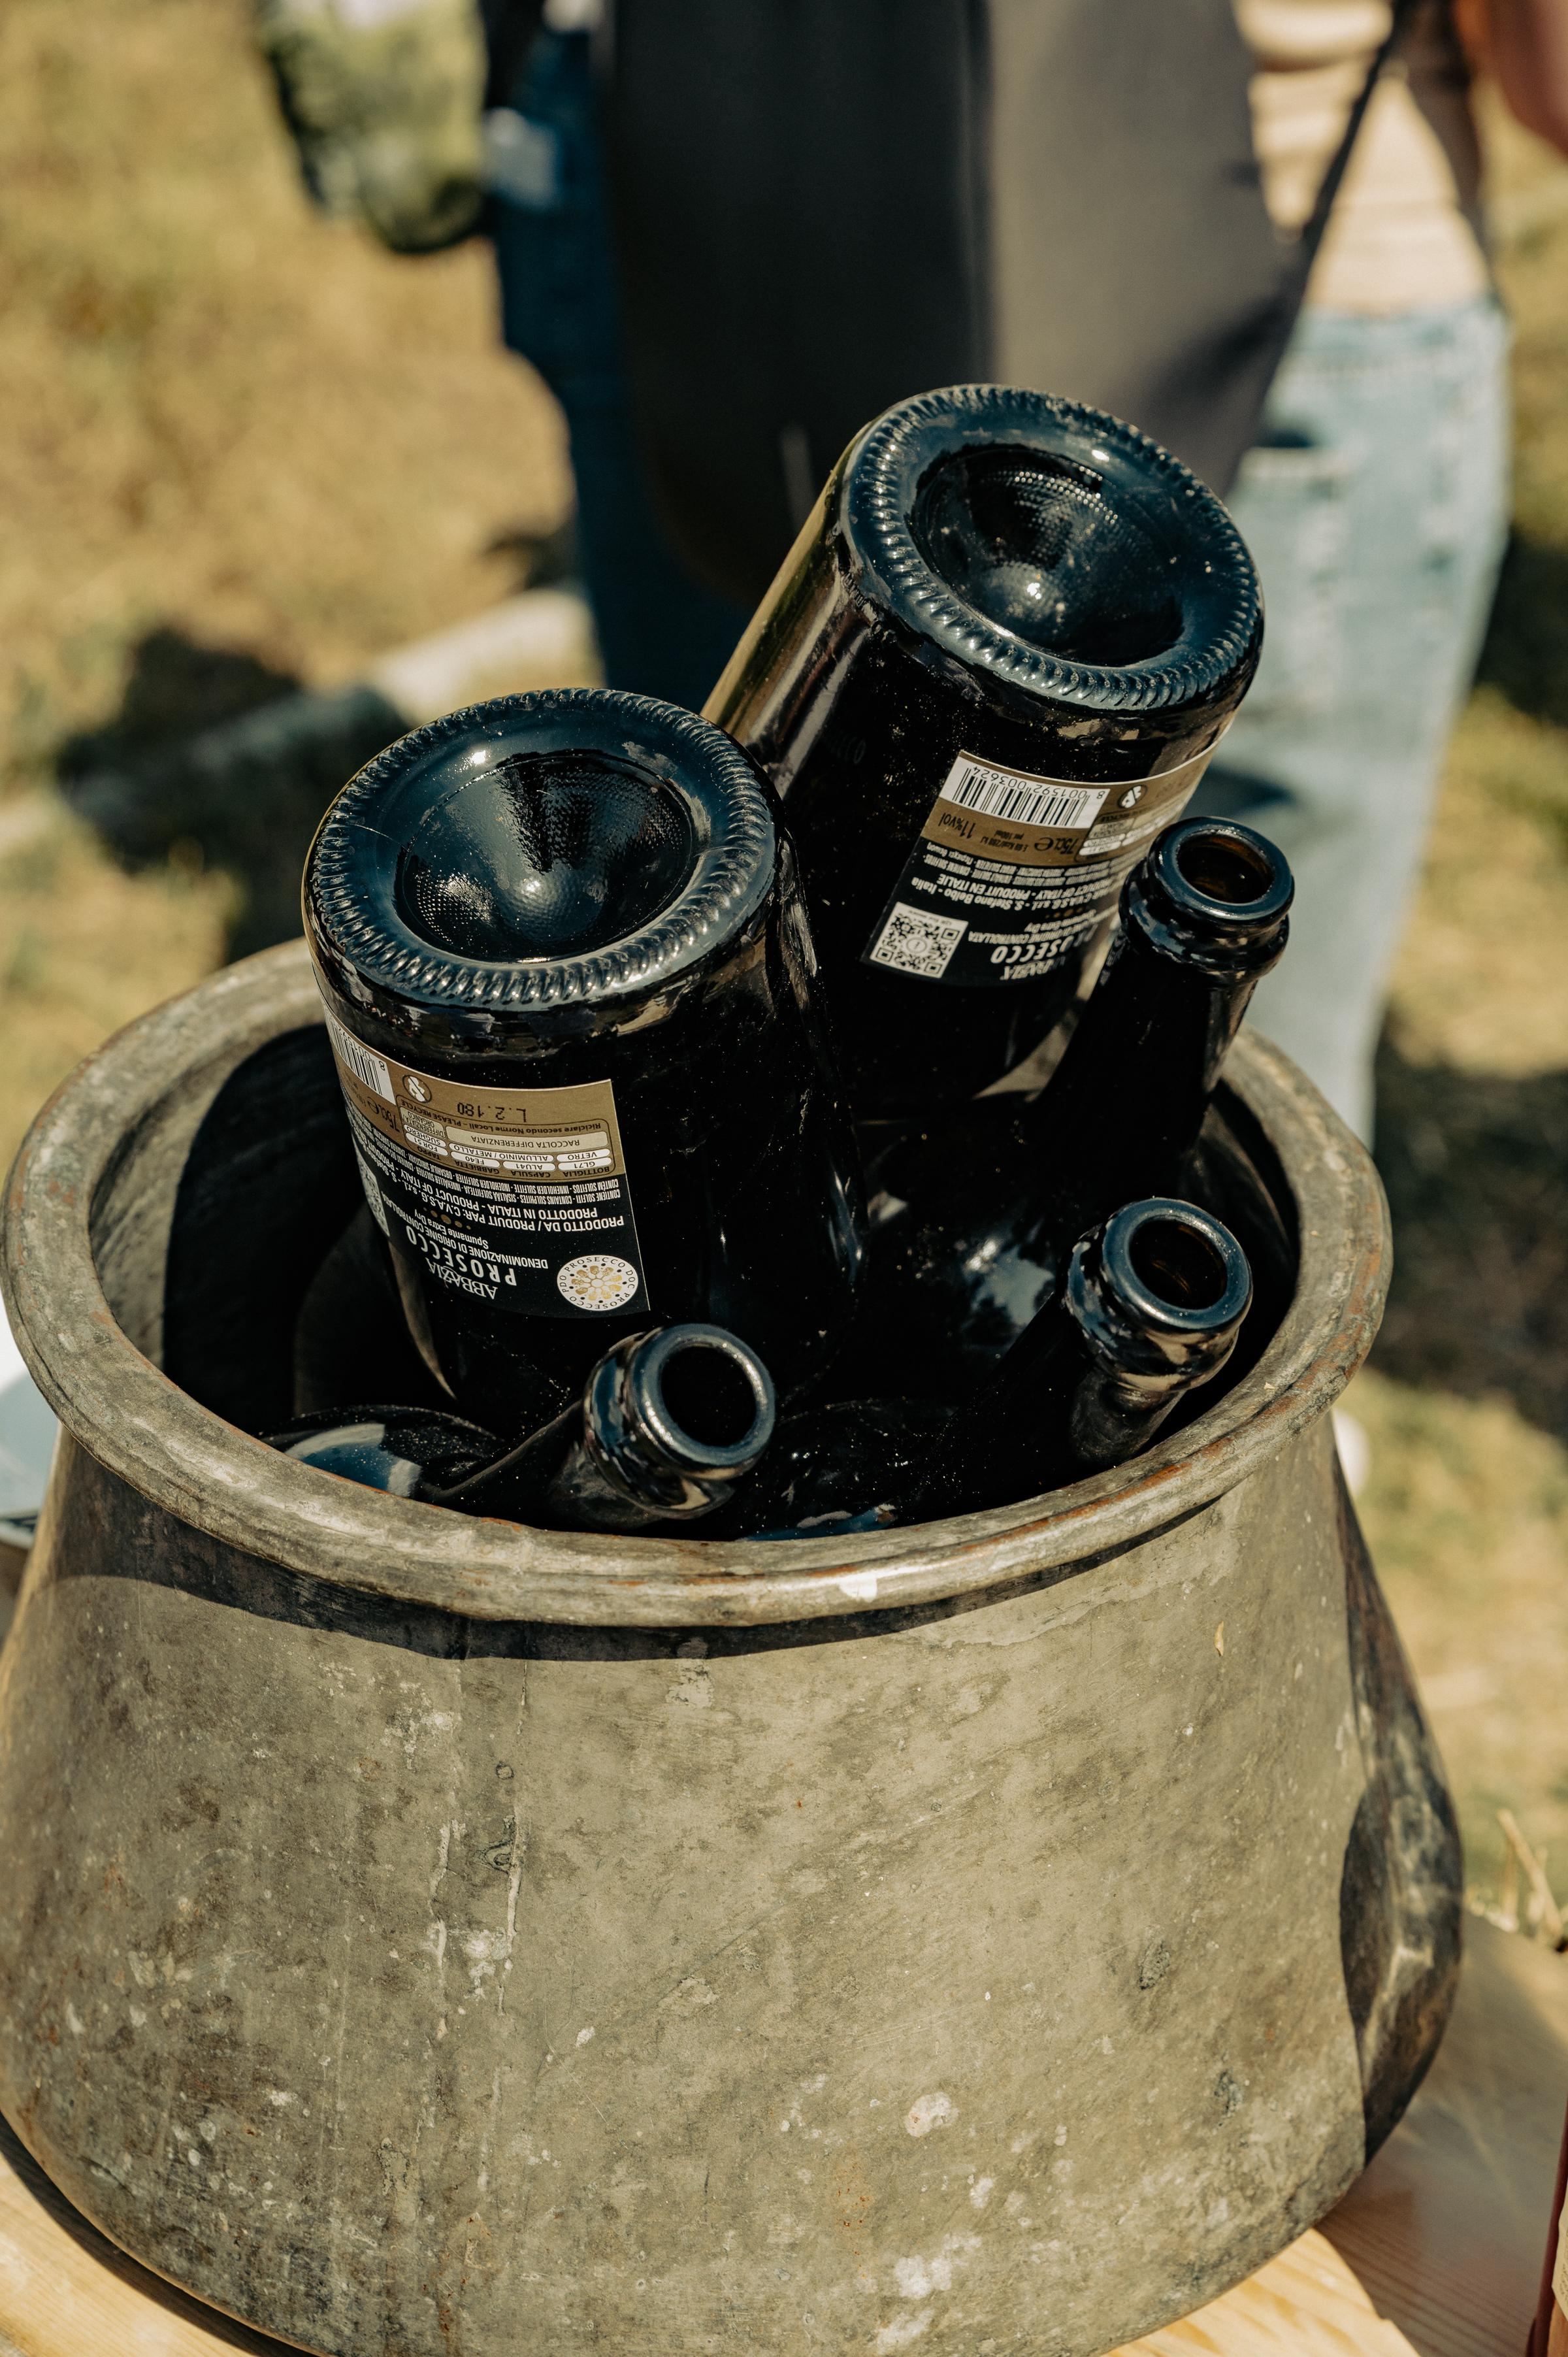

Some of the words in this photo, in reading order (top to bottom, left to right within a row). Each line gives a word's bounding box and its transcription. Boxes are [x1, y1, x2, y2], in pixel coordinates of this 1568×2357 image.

[972, 765, 1027, 790] 003624
[1032, 783, 1087, 799] 001592
[1096, 790, 1105, 800] 8
[911, 877, 938, 895] Italia
[936, 873, 970, 891] ITALIE
[968, 882, 987, 895] EN
[944, 888, 974, 904] Belbo
[985, 885, 1031, 900] PRODUIT
[974, 895, 1013, 910] Stefano
[378, 1060, 385, 1072] 8
[400, 1100, 431, 1118] RECYCLE
[405, 1116, 444, 1138] DIFFERENZIATA
[407, 1112, 434, 1128] ORGANICO
[433, 1113, 461, 1127] PLEASE
[469, 1123, 493, 1132] Locali
[564, 1123, 601, 1132] Riciclare
[406, 1127, 440, 1146] SUGHERO
[470, 1136, 534, 1147] DIFFERENZIATA
[536, 1139, 580, 1148] RACCOLTA
[417, 1146, 440, 1161] TAPPO
[423, 1141, 438, 1152] FOR
[453, 1146, 492, 1157] METALLO
[465, 1156, 485, 1165] FE40
[498, 1153, 548, 1161] ALLUMINIO
[567, 1151, 598, 1161] VETRO
[400, 1169, 421, 1189] ITALY
[510, 1170, 551, 1178] CAPSULA
[563, 1166, 610, 1178] BOTTIGLIA
[455, 1172, 479, 1187] SULFITTER
[480, 1179, 510, 1192] INDEHOLDER
[597, 1178, 619, 1191] CONTÉM
[422, 1182, 433, 1195] OF
[514, 1183, 536, 1194] SULFITTE
[536, 1185, 569, 1195] INNEHOLDER
[572, 1183, 597, 1194] SULFITOS
[596, 1189, 621, 1202] CONTIENE
[434, 1187, 480, 1211] PRODUCT
[519, 1194, 546, 1204] SULPHITES
[546, 1195, 572, 1205] CONTAINS
[576, 1193, 596, 1204] SOLFITI
[414, 1209, 427, 1225] Dry
[462, 1208, 485, 1224] PAR:
[487, 1203, 521, 1217] ITALIA
[523, 1208, 536, 1219] IN
[538, 1207, 598, 1220] PRODOTTO
[427, 1218, 447, 1235] Extra
[487, 1215, 536, 1231] PRODUIT
[543, 1221, 561, 1232] DA
[563, 1215, 625, 1232] PRODOTTO
[424, 1227, 457, 1250] ORIGINE
[447, 1228, 489, 1249] Spumante
[457, 1242, 467, 1253] DI
[406, 1225, 517, 1286] PROSECCO
[468, 1246, 548, 1269] DENOMINAZIONE
[425, 1257, 498, 1300] ABBAZIA
[564, 1256, 626, 1273] PROSECCO
[625, 1270, 636, 1289] DOC
[568, 1292, 629, 1310] PROSECCO
